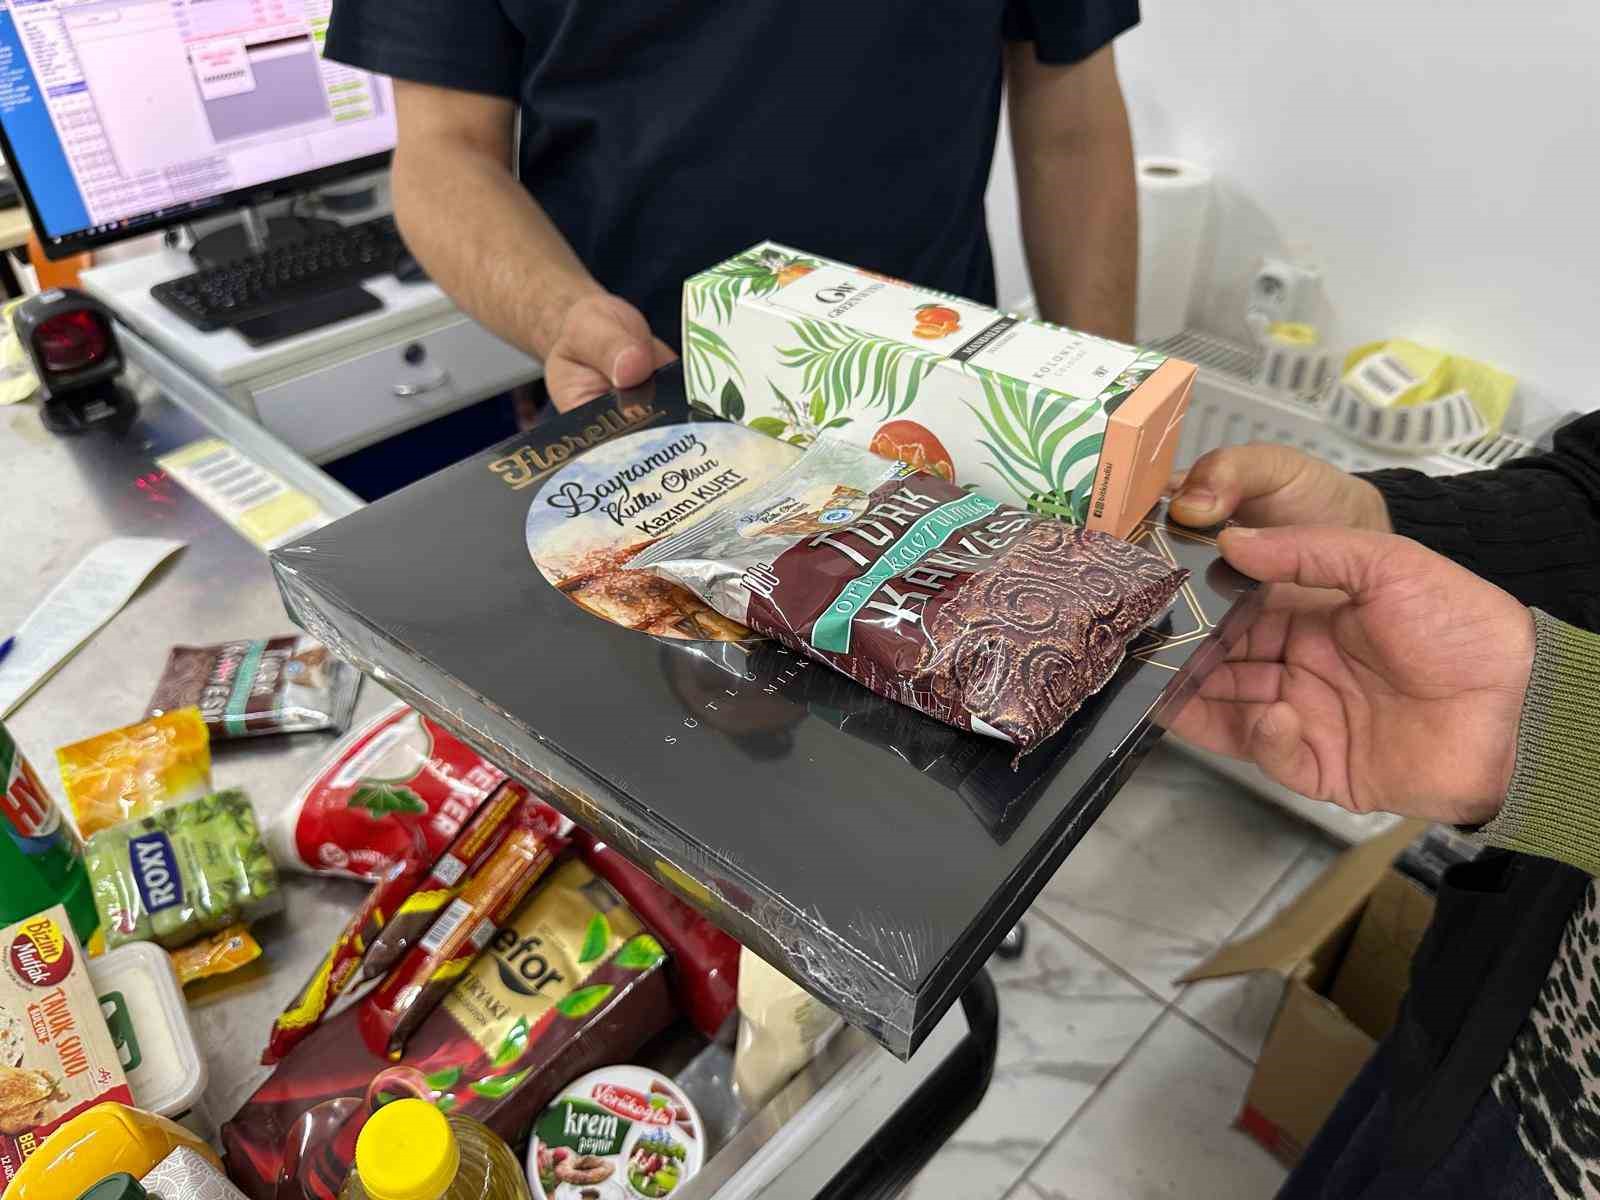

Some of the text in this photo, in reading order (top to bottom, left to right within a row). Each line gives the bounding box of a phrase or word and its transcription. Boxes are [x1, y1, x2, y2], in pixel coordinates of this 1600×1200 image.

[1032, 340, 1082, 379] KOLONYA
[600, 492, 663, 526] Kutlu
[661, 458, 720, 493] Olsun
[635, 498, 698, 535] Kazım
[691, 468, 742, 500] KURT
[762, 659, 809, 695] MILK
[135, 840, 176, 907] ROXY
[27, 918, 59, 958] Bizim
[13, 942, 51, 984] Mutfak
[494, 928, 564, 993] efor
[41, 987, 89, 1078] TAVUK SUYU
[564, 1103, 617, 1135] krem
[19, 1132, 37, 1157] BED
